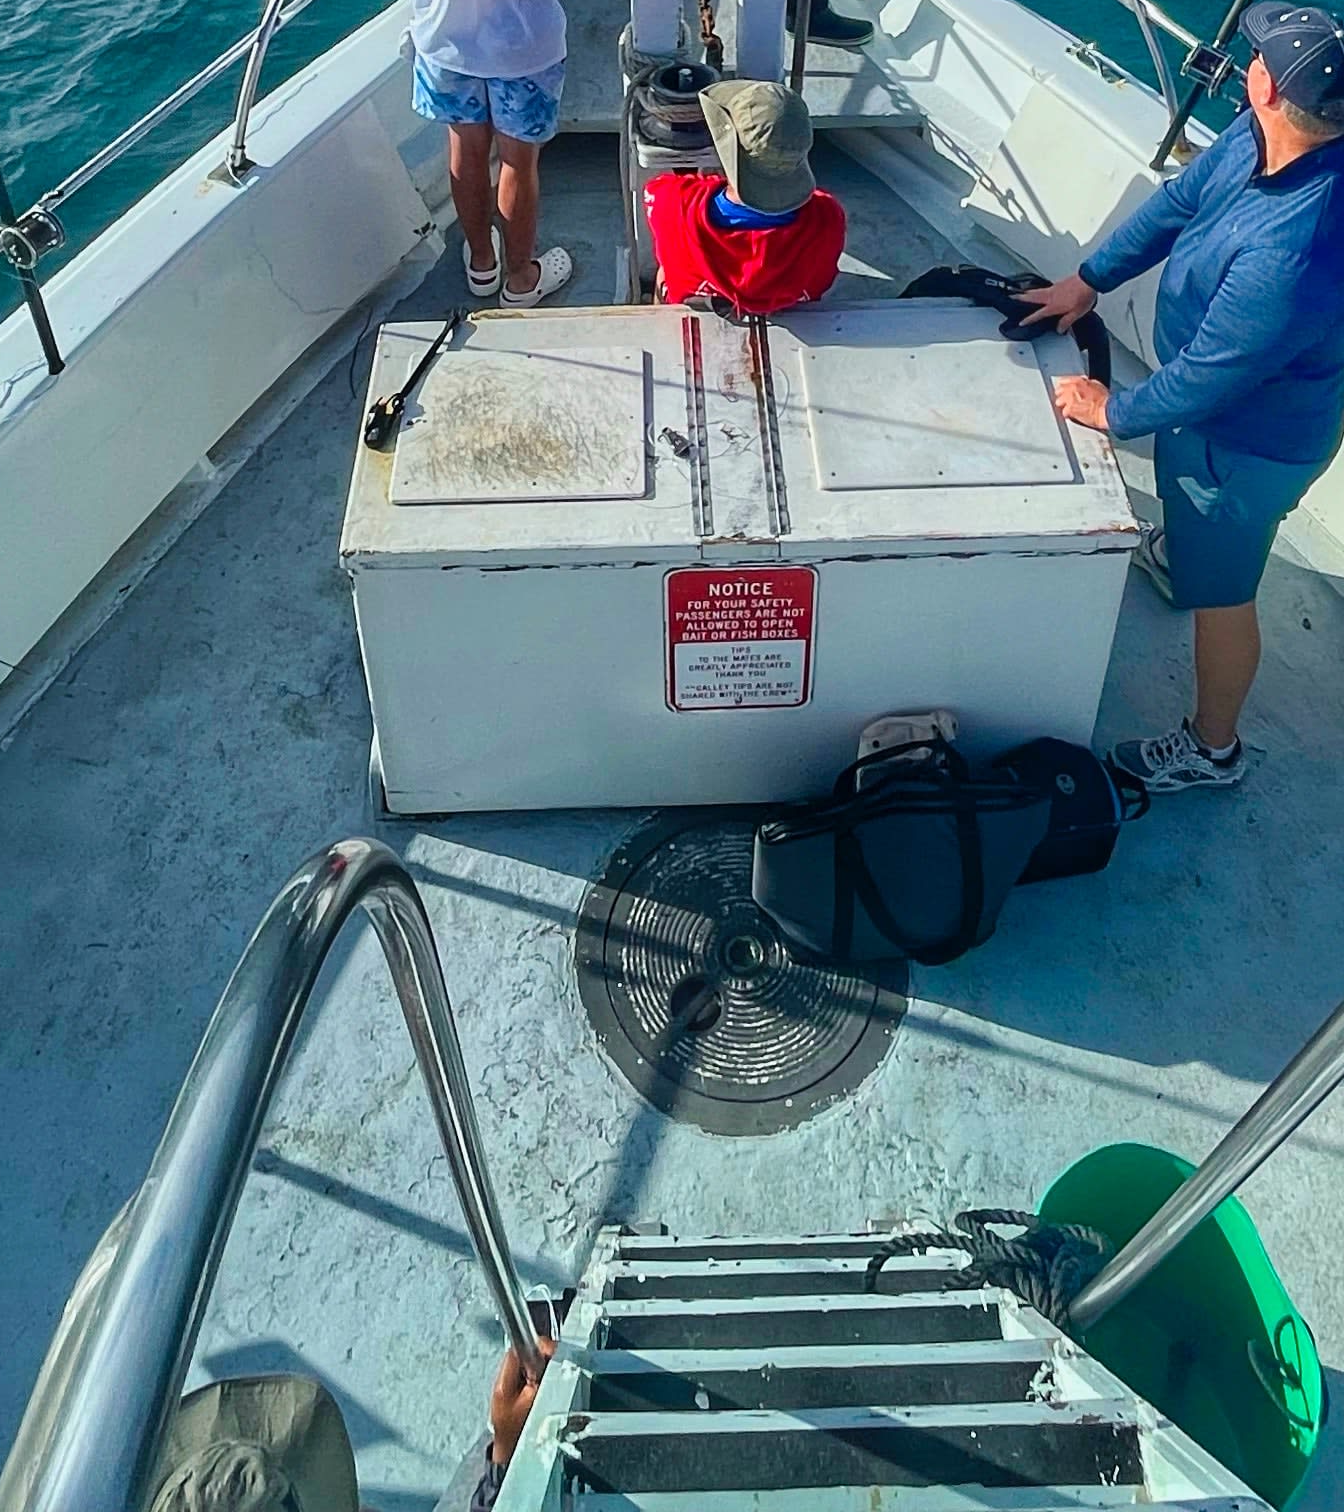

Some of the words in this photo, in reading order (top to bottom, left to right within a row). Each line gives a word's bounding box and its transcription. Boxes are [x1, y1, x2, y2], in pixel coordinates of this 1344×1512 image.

[709, 582, 774, 597] NOTICE
[687, 601, 710, 610] FOR
[714, 599, 746, 608] YOUR
[751, 598, 793, 608] SAFETY
[675, 610, 751, 621] PASSENGERS
[755, 609, 777, 618] ARE
[782, 608, 805, 617] NOT
[686, 620, 740, 631] ALLOWED
[744, 620, 757, 628] TO
[761, 619, 794, 628] OPEN
[682, 632, 707, 641] BAIT
[711, 631, 727, 640] OR
[731, 630, 757, 639] FISH
[761, 629, 798, 638] BOXES
[731, 646, 751, 654] TIPS
[733, 654, 761, 662] MATES
[688, 663, 727, 672] GREATLY
[730, 661, 791, 669] APPRECIATED
